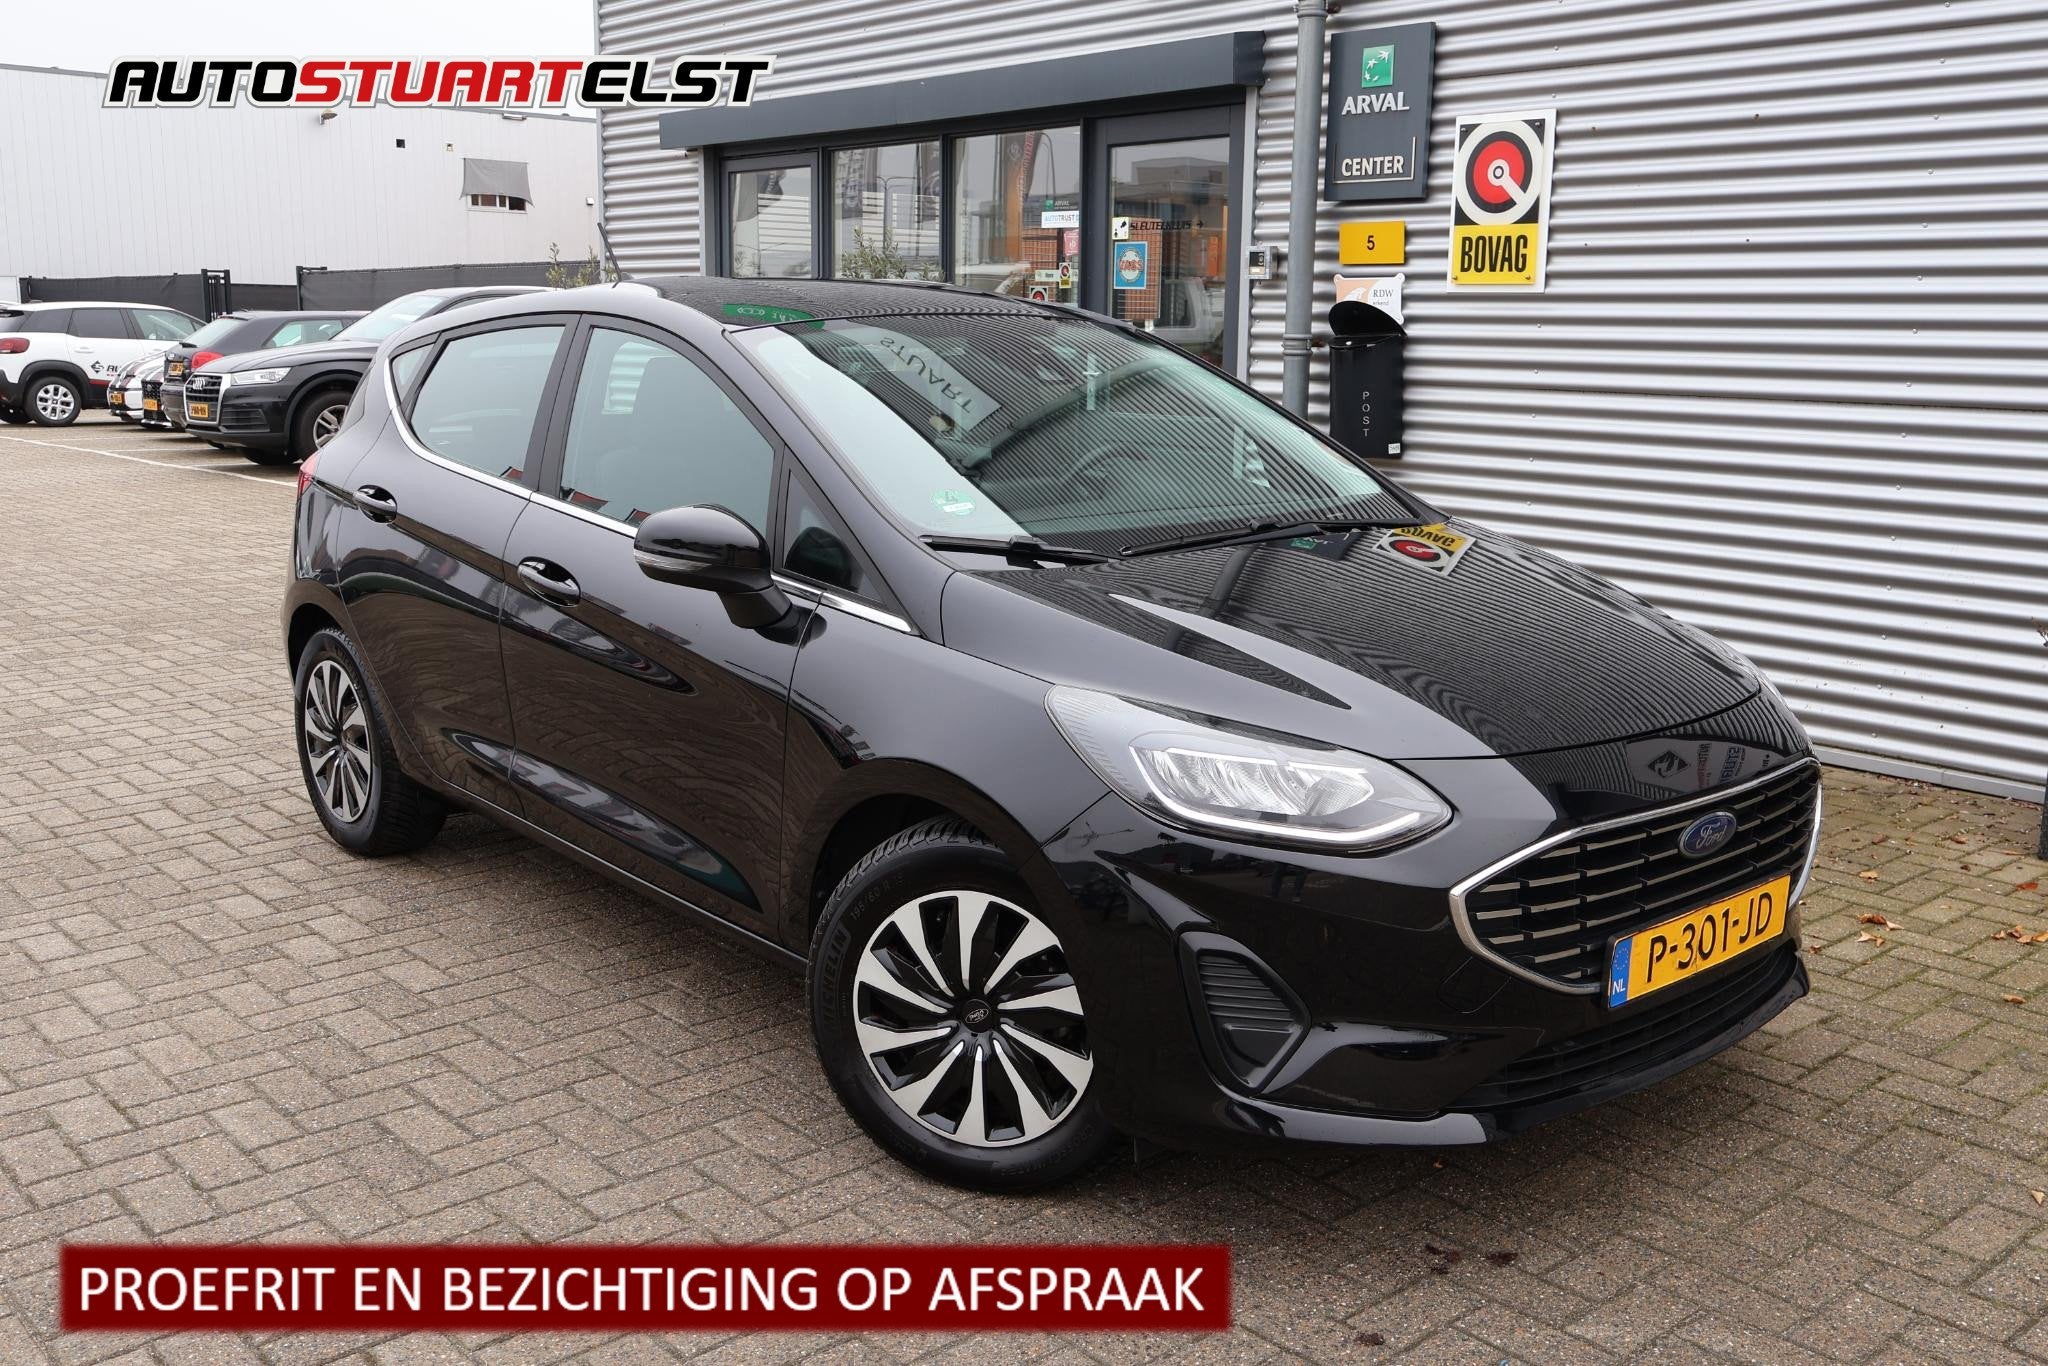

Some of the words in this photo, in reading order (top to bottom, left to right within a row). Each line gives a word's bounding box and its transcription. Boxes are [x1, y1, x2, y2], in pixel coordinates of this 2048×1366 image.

[1341, 91, 1410, 115] ARVAL
[1341, 155, 1404, 177] CENTER
[1366, 235, 1376, 251] 5
[1460, 234, 1528, 273] BOVAG
[1372, 289, 1394, 298] RDW
[1362, 391, 1371, 437] POST
[1695, 821, 1729, 850] Ford
[1612, 978, 1626, 994] NL
[1645, 891, 1773, 984] P-301-JD
